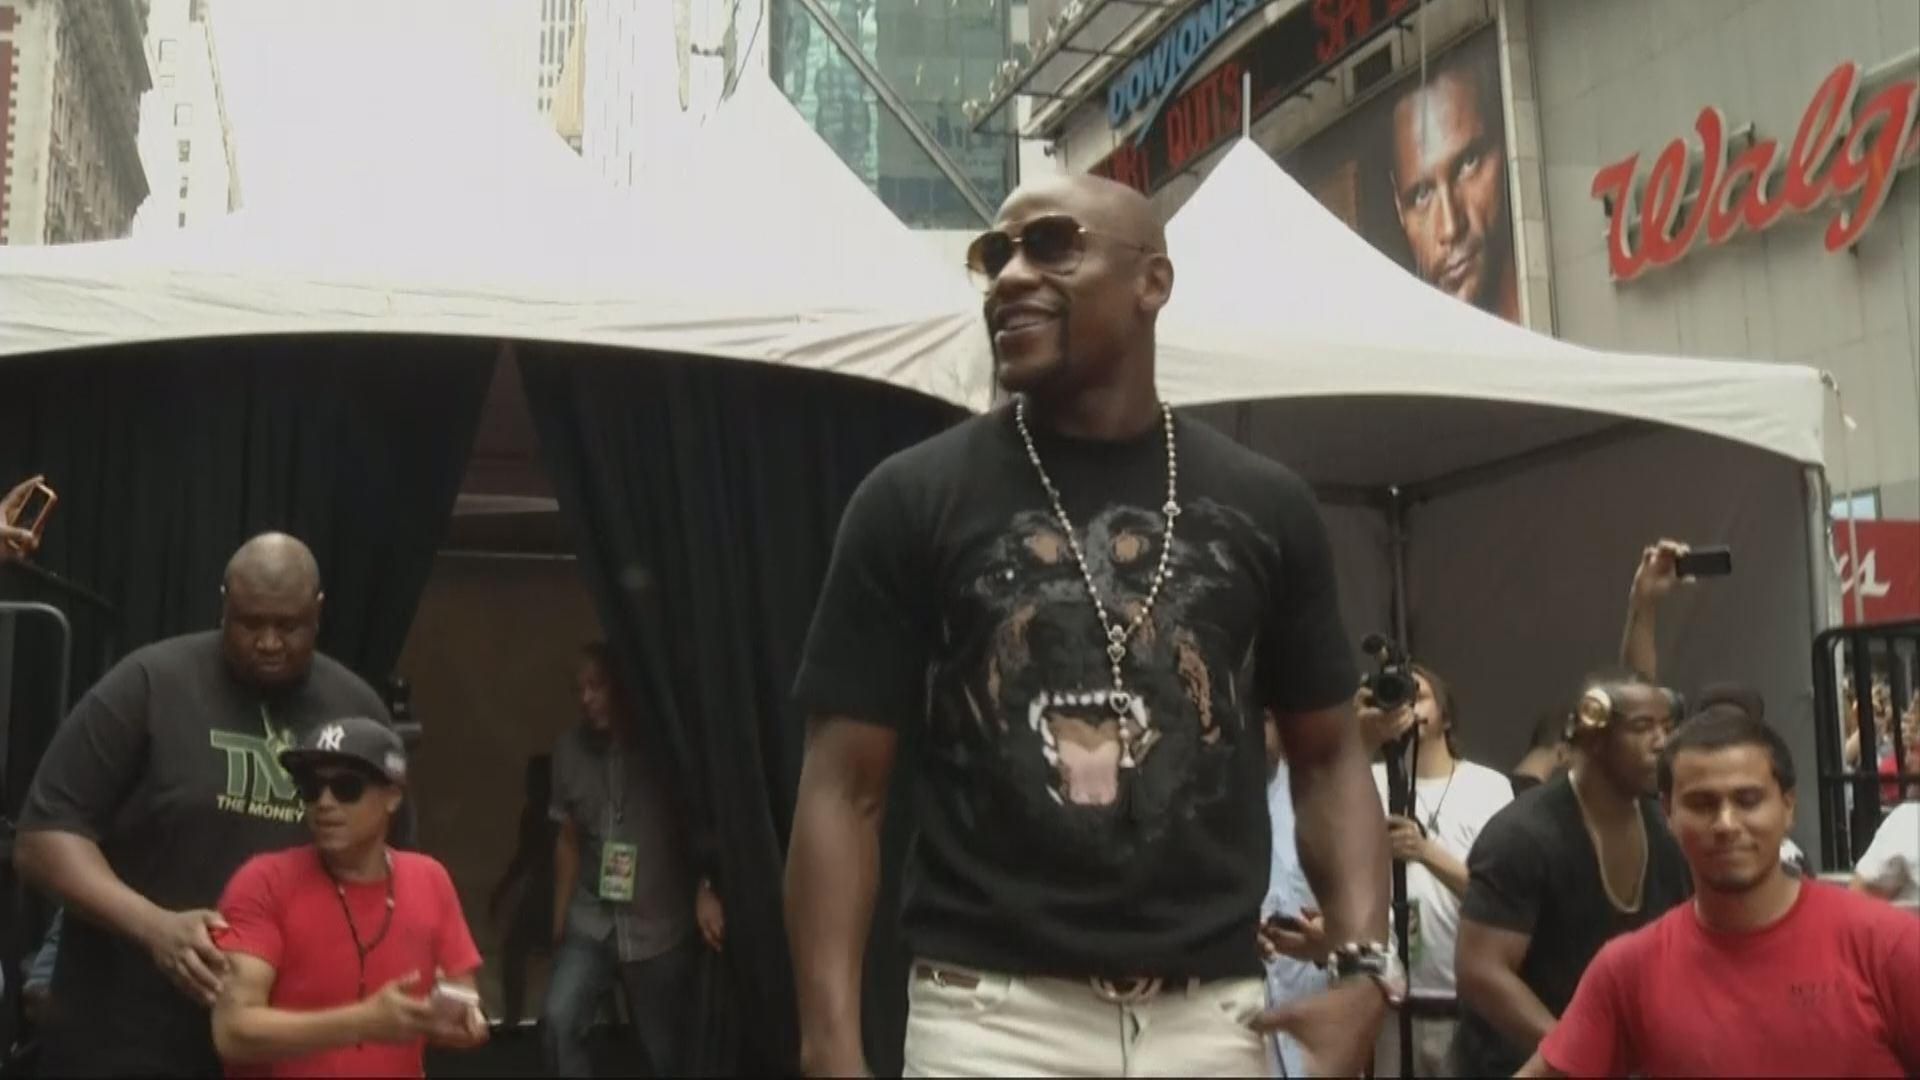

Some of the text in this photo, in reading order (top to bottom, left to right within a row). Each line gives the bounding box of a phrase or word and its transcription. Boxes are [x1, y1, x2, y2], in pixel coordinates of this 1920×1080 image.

[1591, 60, 1919, 281] Walg
[316, 723, 345, 750] NY
[216, 794, 304, 823] THE MONEY
